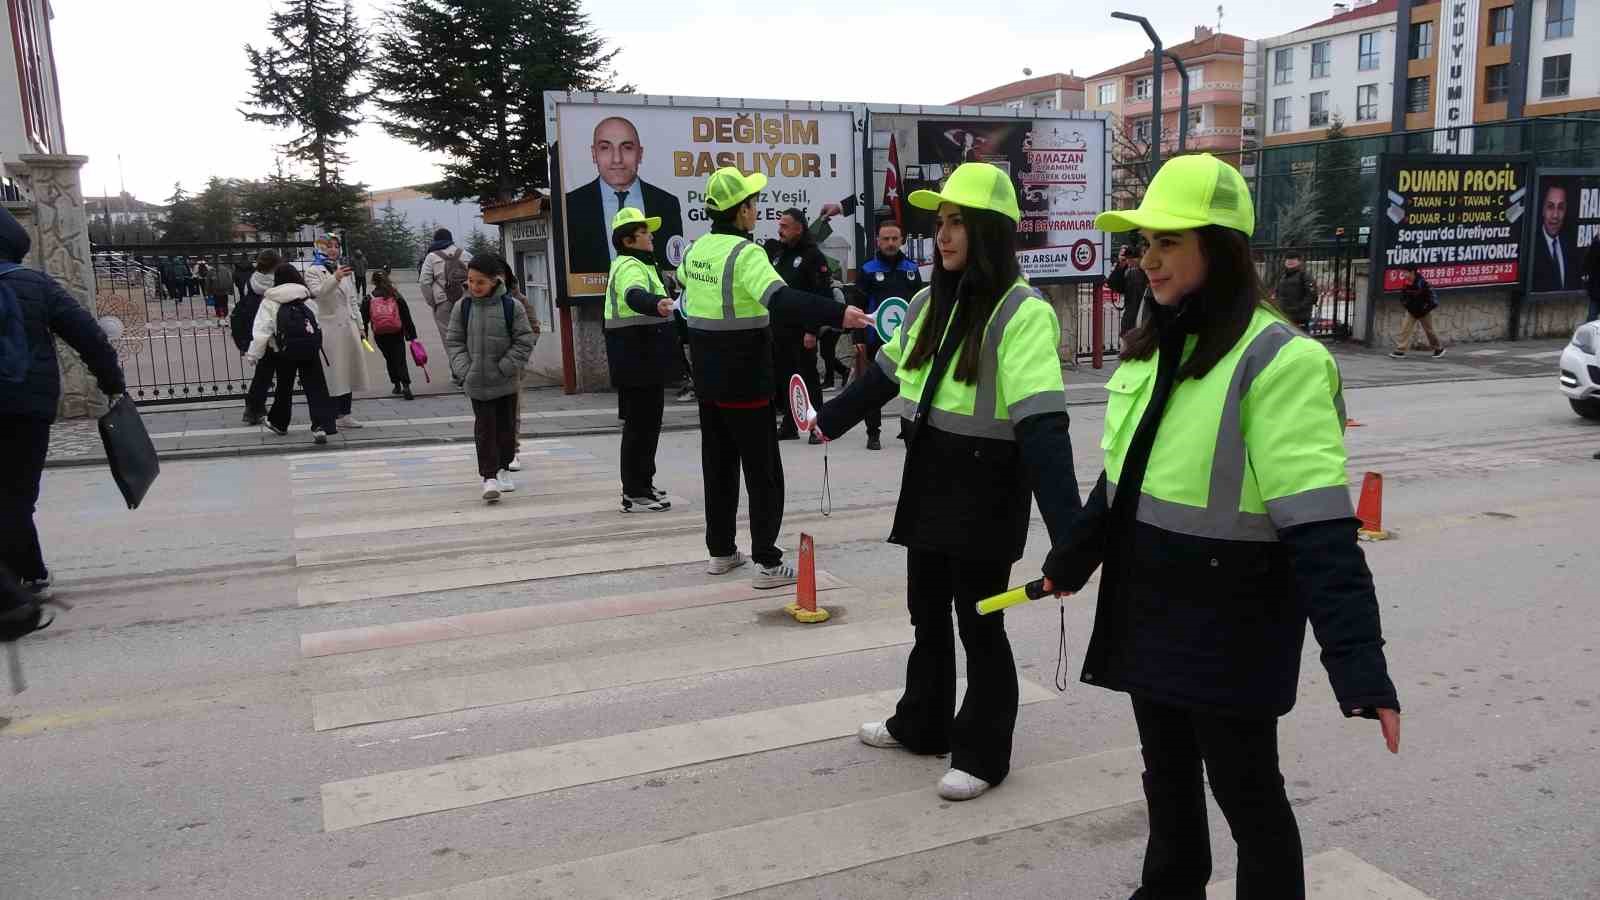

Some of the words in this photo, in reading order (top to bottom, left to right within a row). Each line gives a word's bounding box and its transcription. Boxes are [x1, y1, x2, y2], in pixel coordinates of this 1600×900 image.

[1446, 2, 1466, 154] KUYUMCU
[692, 112, 819, 149] DEĞİŞİM
[1028, 152, 1084, 164] RAMAZAN
[1061, 172, 1087, 180] OLSUN
[1398, 169, 1460, 193] DUMAN
[1463, 162, 1517, 192] PROFİL
[772, 190, 810, 206] Yeşil,
[1412, 196, 1442, 208] TAVAN
[1450, 196, 1456, 207] U
[1463, 195, 1491, 207] TAVAN
[1498, 195, 1504, 206] C
[1579, 188, 1600, 219] RA
[766, 207, 810, 221] Esf,
[1408, 213, 1440, 225] DUVAR
[1448, 212, 1455, 223] U
[1462, 211, 1492, 223] DUVAR
[1499, 211, 1505, 222] C
[1398, 227, 1455, 243] Sorgun'da
[1456, 224, 1511, 241] Üretiyoruz
[1032, 253, 1068, 264] ARSLAN
[1386, 244, 1456, 265] TÜRKİYE'YE
[1457, 243, 1518, 261] SATIYORUZ
[1504, 264, 1513, 273] 22
